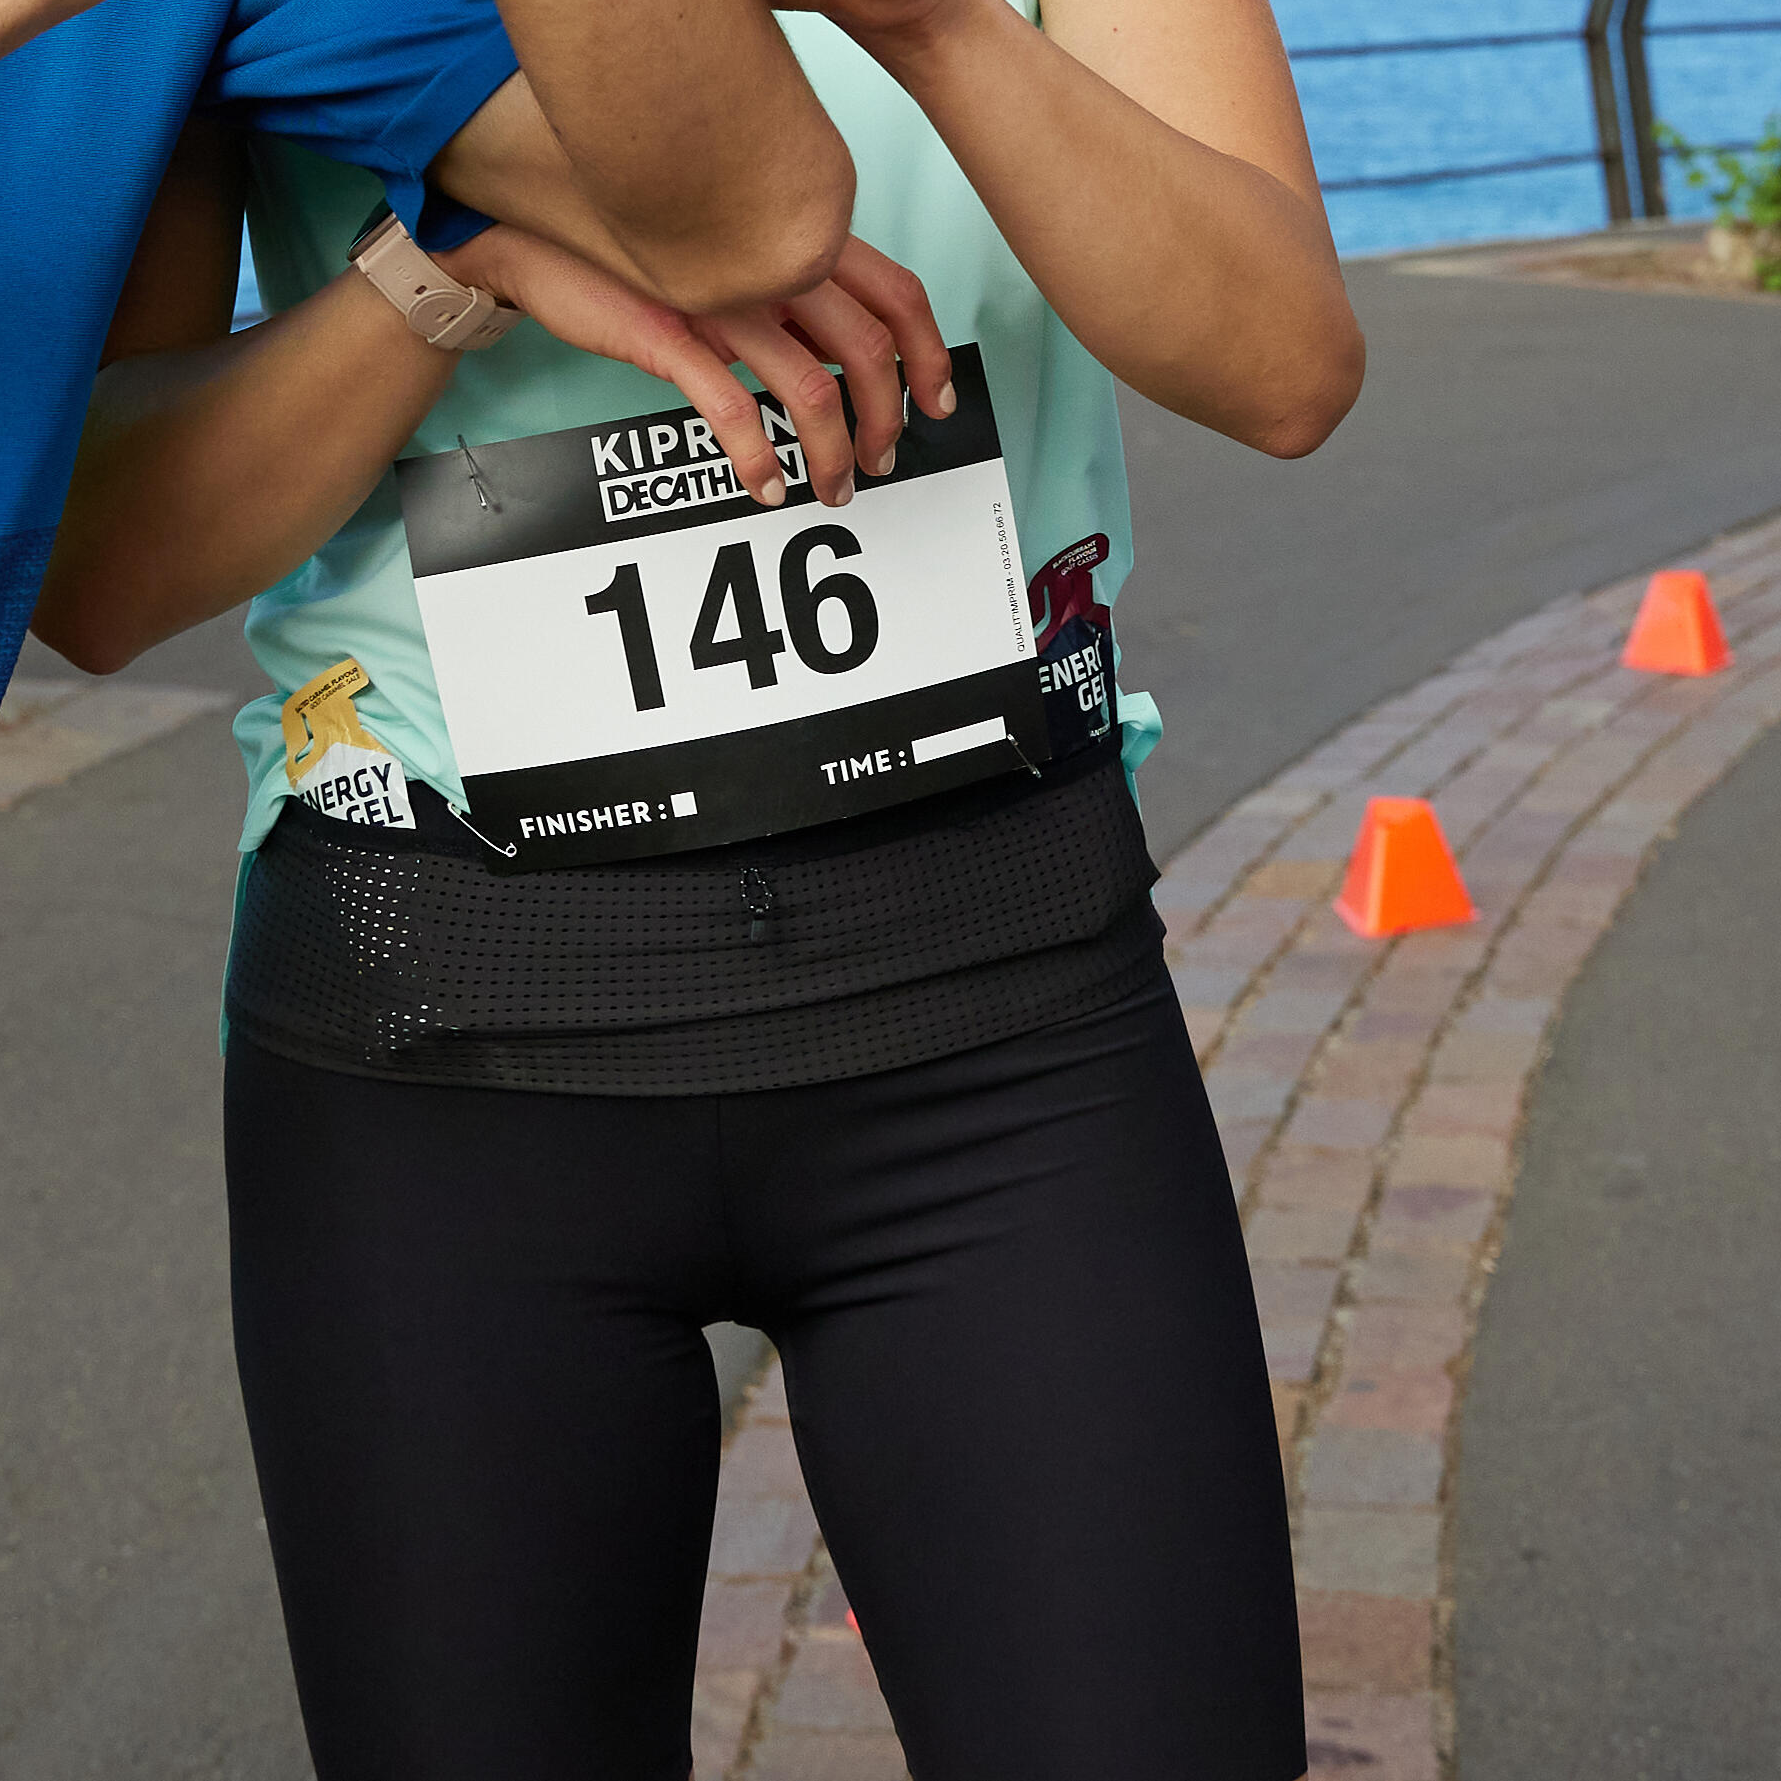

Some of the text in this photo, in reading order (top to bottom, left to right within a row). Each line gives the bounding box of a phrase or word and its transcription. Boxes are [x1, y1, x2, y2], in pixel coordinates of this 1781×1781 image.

[590, 404, 798, 476] KIPRN
[606, 449, 800, 516] DECATHN
[584, 523, 880, 714] 146
[346, 796, 404, 826] GEL
